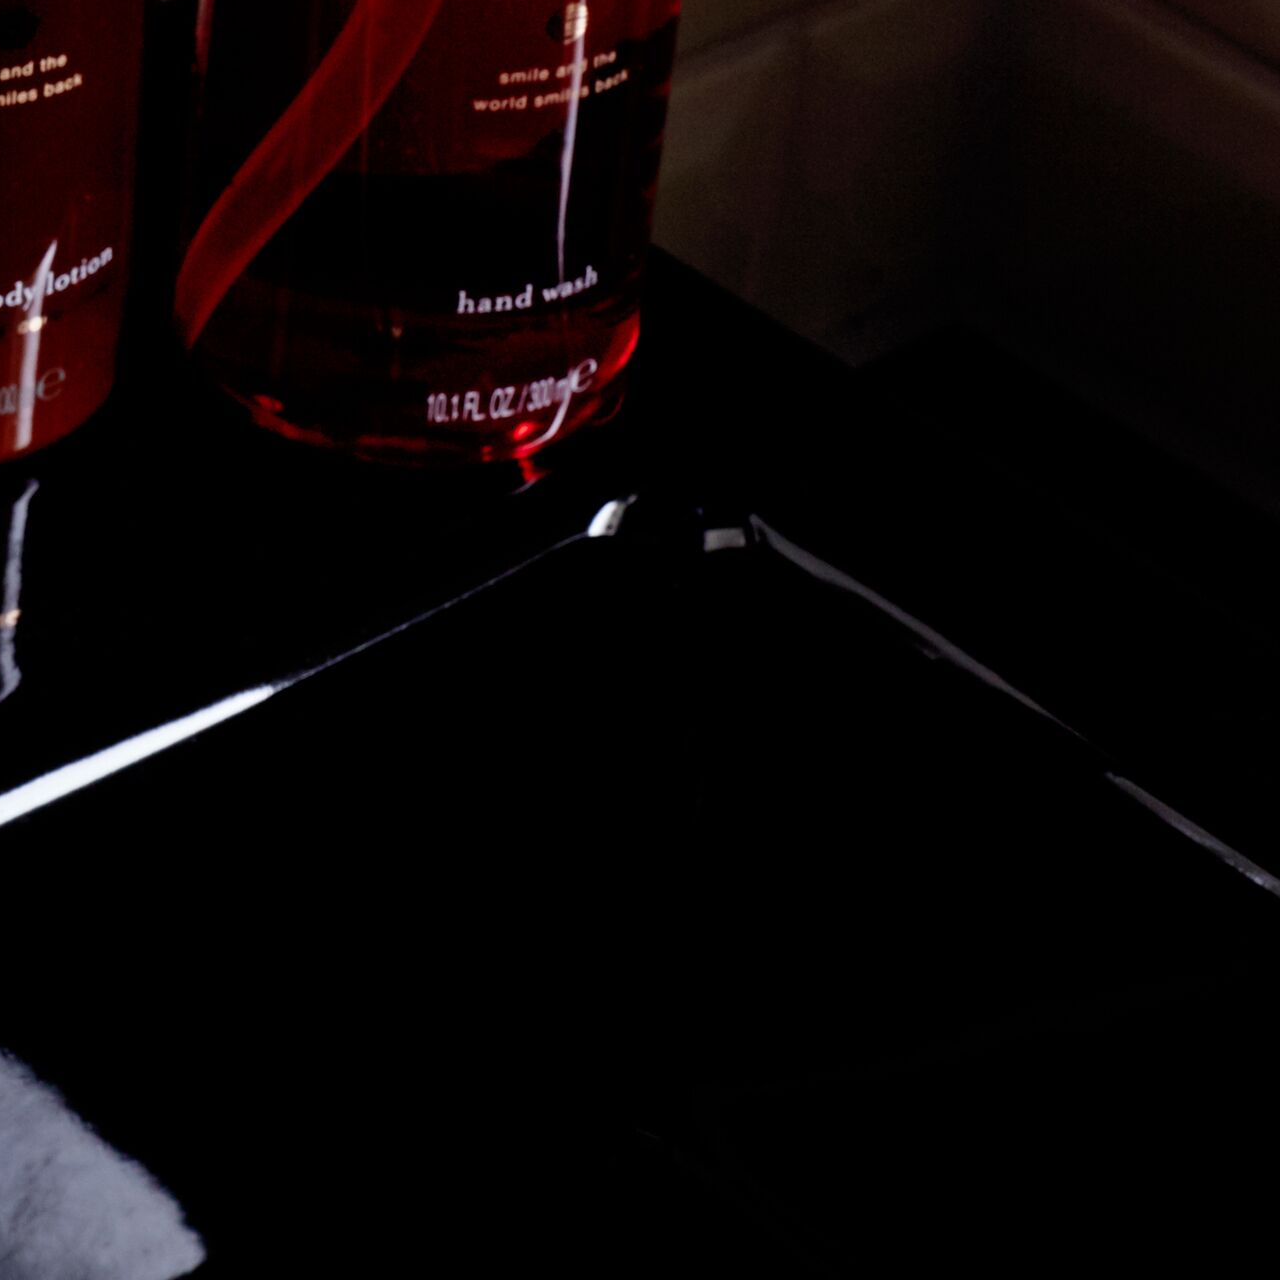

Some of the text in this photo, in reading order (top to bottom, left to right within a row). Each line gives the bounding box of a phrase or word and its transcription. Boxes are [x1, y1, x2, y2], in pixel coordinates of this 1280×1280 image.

[0, 60, 35, 82] and
[40, 53, 69, 75] the
[43, 72, 84, 99] back
[498, 66, 550, 87] smile
[593, 50, 617, 70] the
[472, 95, 528, 113] world
[594, 67, 630, 94] back
[44, 246, 114, 297] lotion
[456, 264, 599, 314] hand wash
[489, 385, 517, 421] OZ
